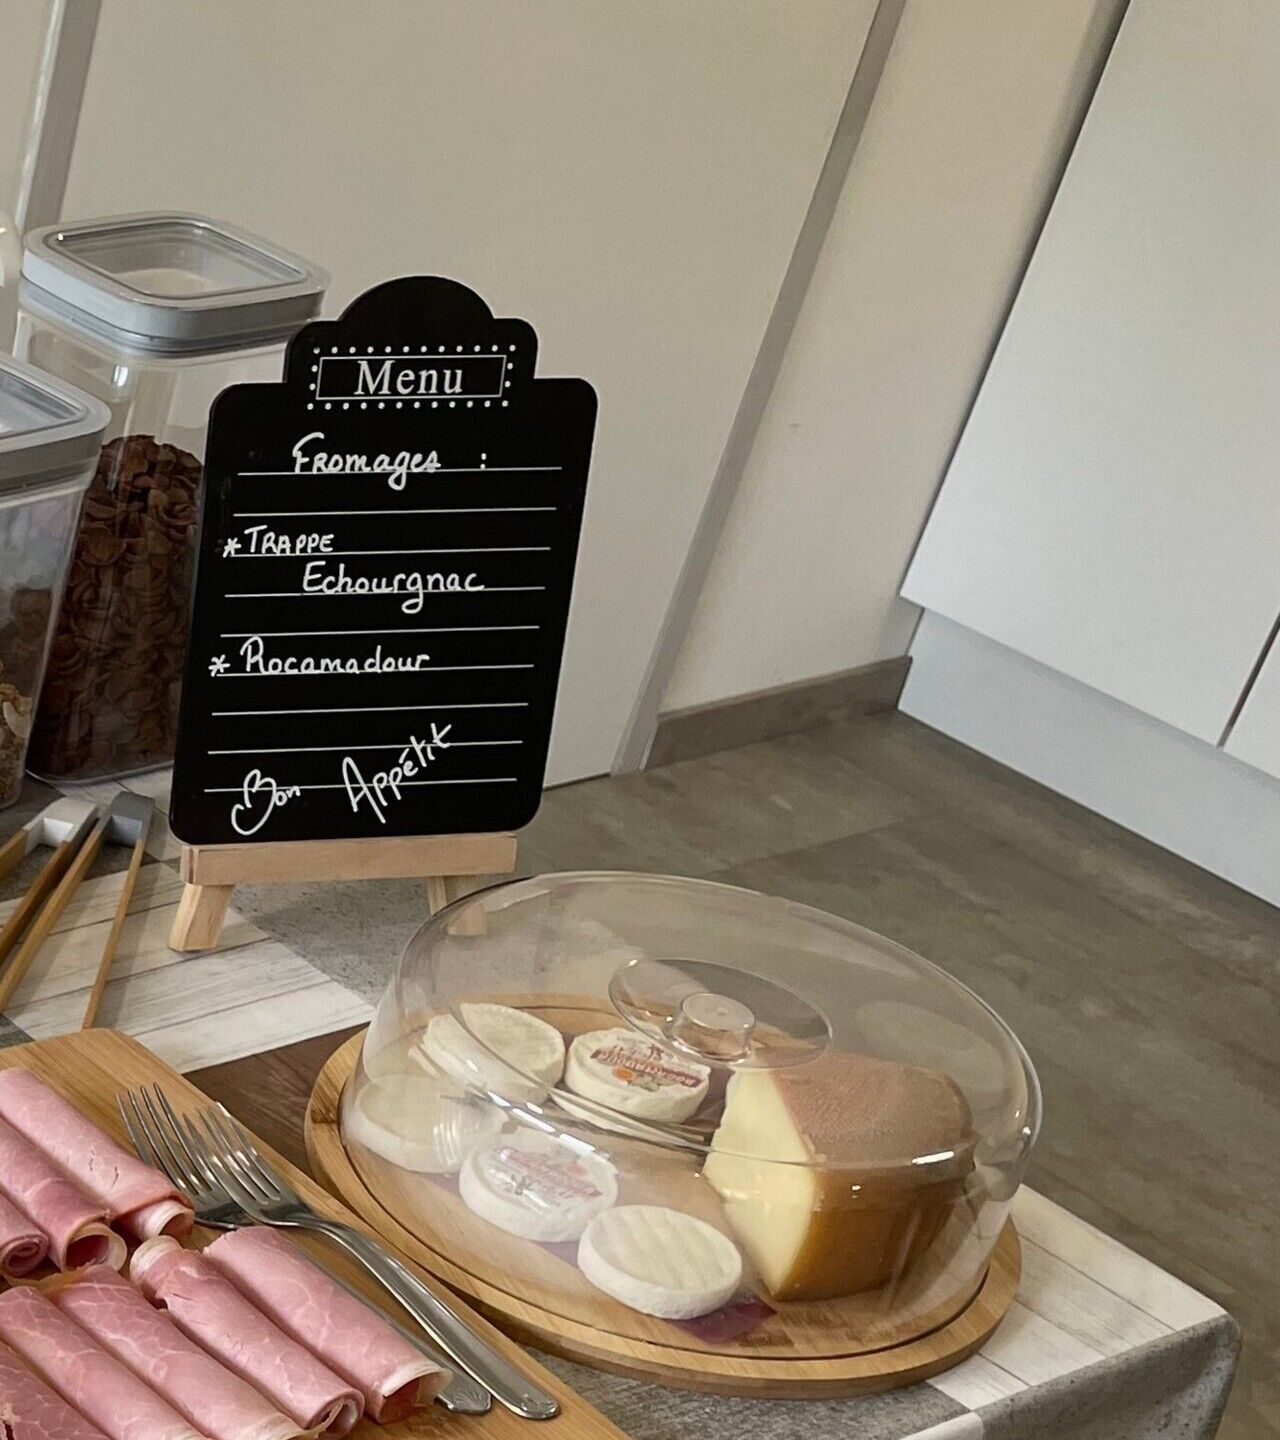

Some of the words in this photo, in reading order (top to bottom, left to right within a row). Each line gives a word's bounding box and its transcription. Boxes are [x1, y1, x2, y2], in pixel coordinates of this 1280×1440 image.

[354, 359, 464, 396] Menu
[302, 561, 486, 614] Echourgnac
[231, 768, 301, 835] Bon
